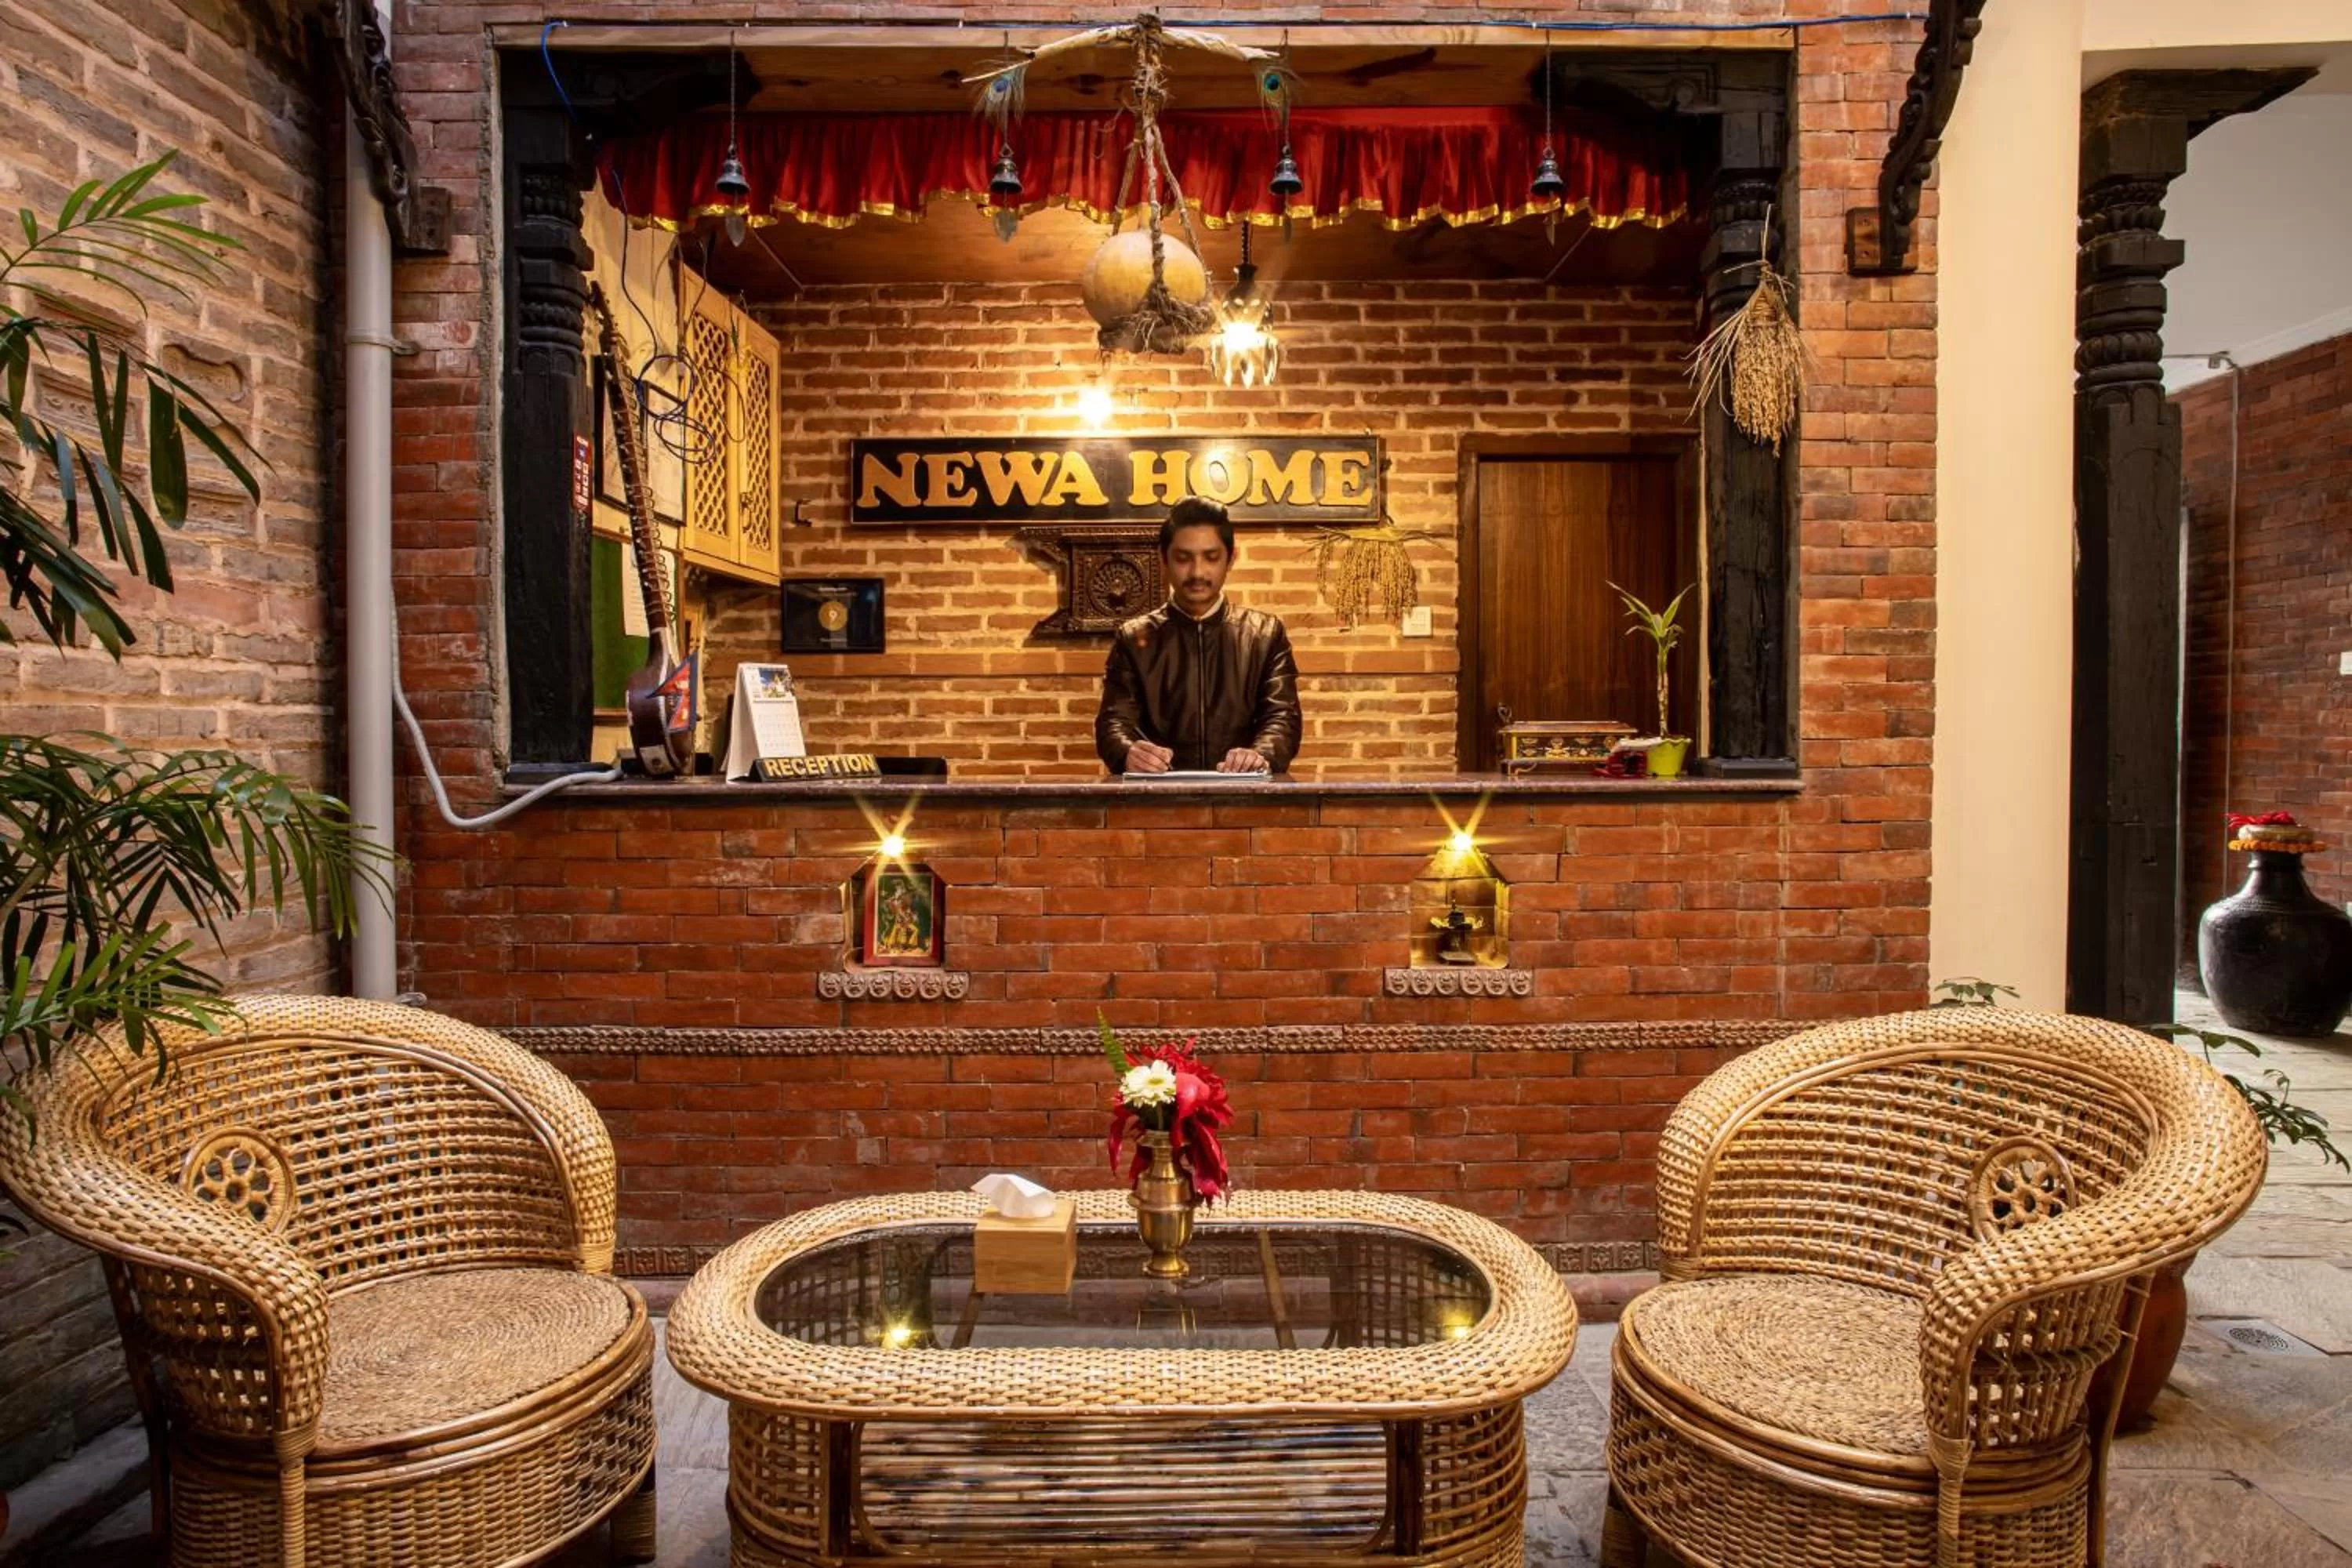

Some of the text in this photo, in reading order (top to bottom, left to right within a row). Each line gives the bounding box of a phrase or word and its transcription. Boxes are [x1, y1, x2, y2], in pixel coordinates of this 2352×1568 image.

[856, 450, 1372, 506] NEWA HOME
[763, 753, 877, 779] RECEPTION
